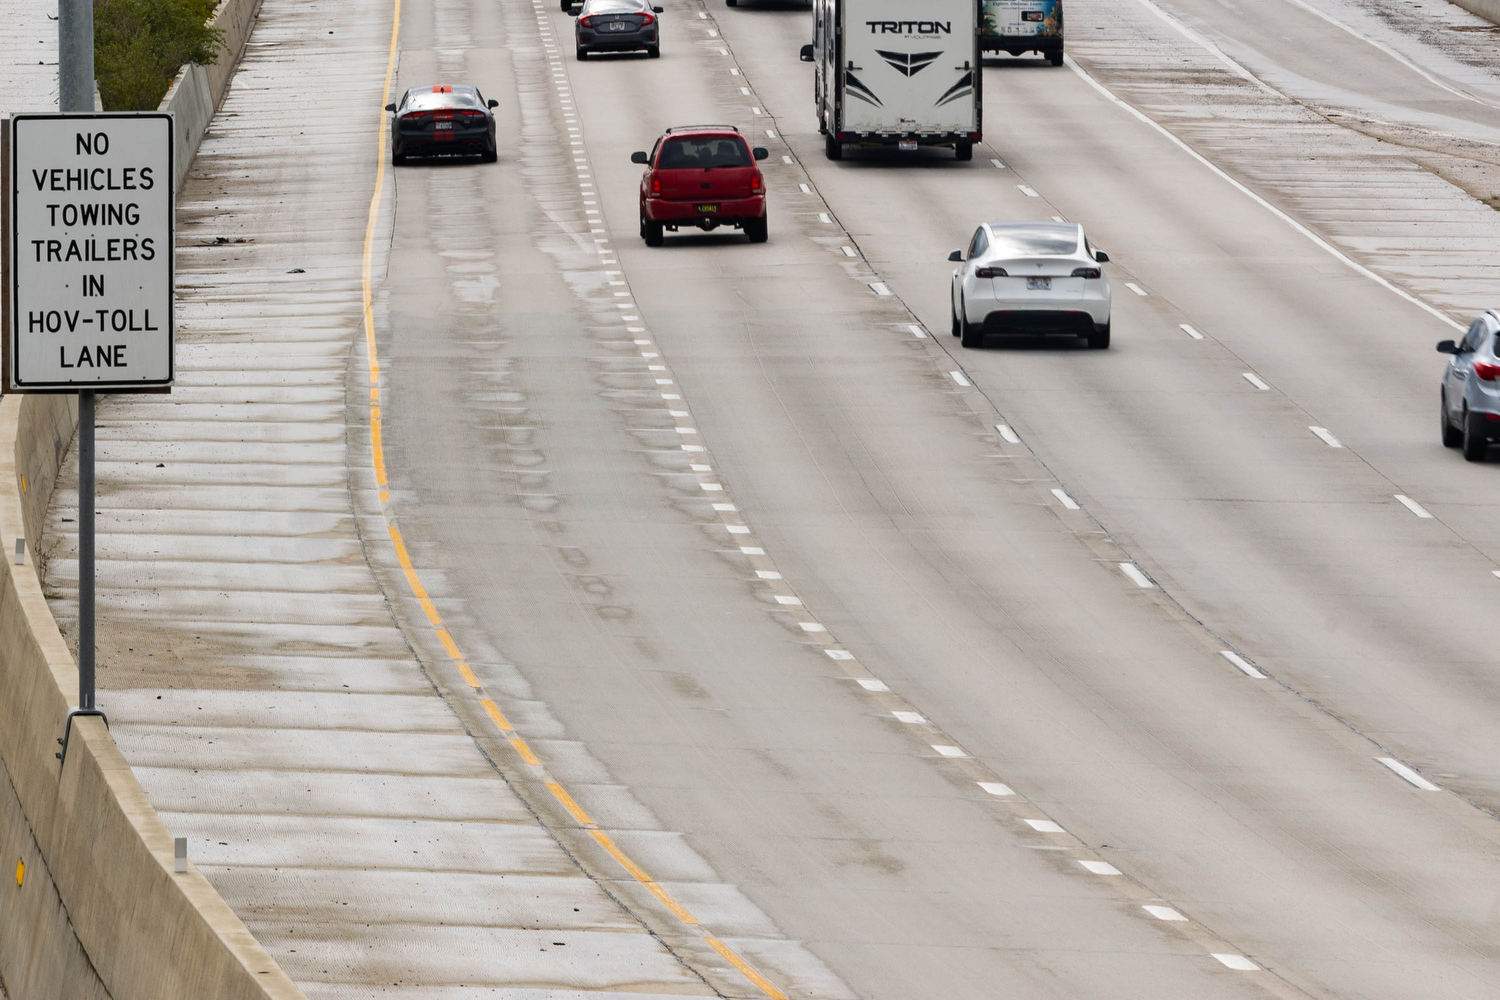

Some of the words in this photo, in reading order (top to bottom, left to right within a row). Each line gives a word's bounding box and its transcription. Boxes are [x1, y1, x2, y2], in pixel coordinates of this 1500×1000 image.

[865, 21, 951, 34] TRITON
[76, 132, 110, 155] NO
[32, 167, 154, 191] VEHICLES
[46, 203, 140, 226] TOWING
[31, 238, 155, 262] TRAILERS
[82, 274, 105, 297] IN
[28, 309, 158, 333] HOV-TOLL
[60, 345, 128, 368] LANE
